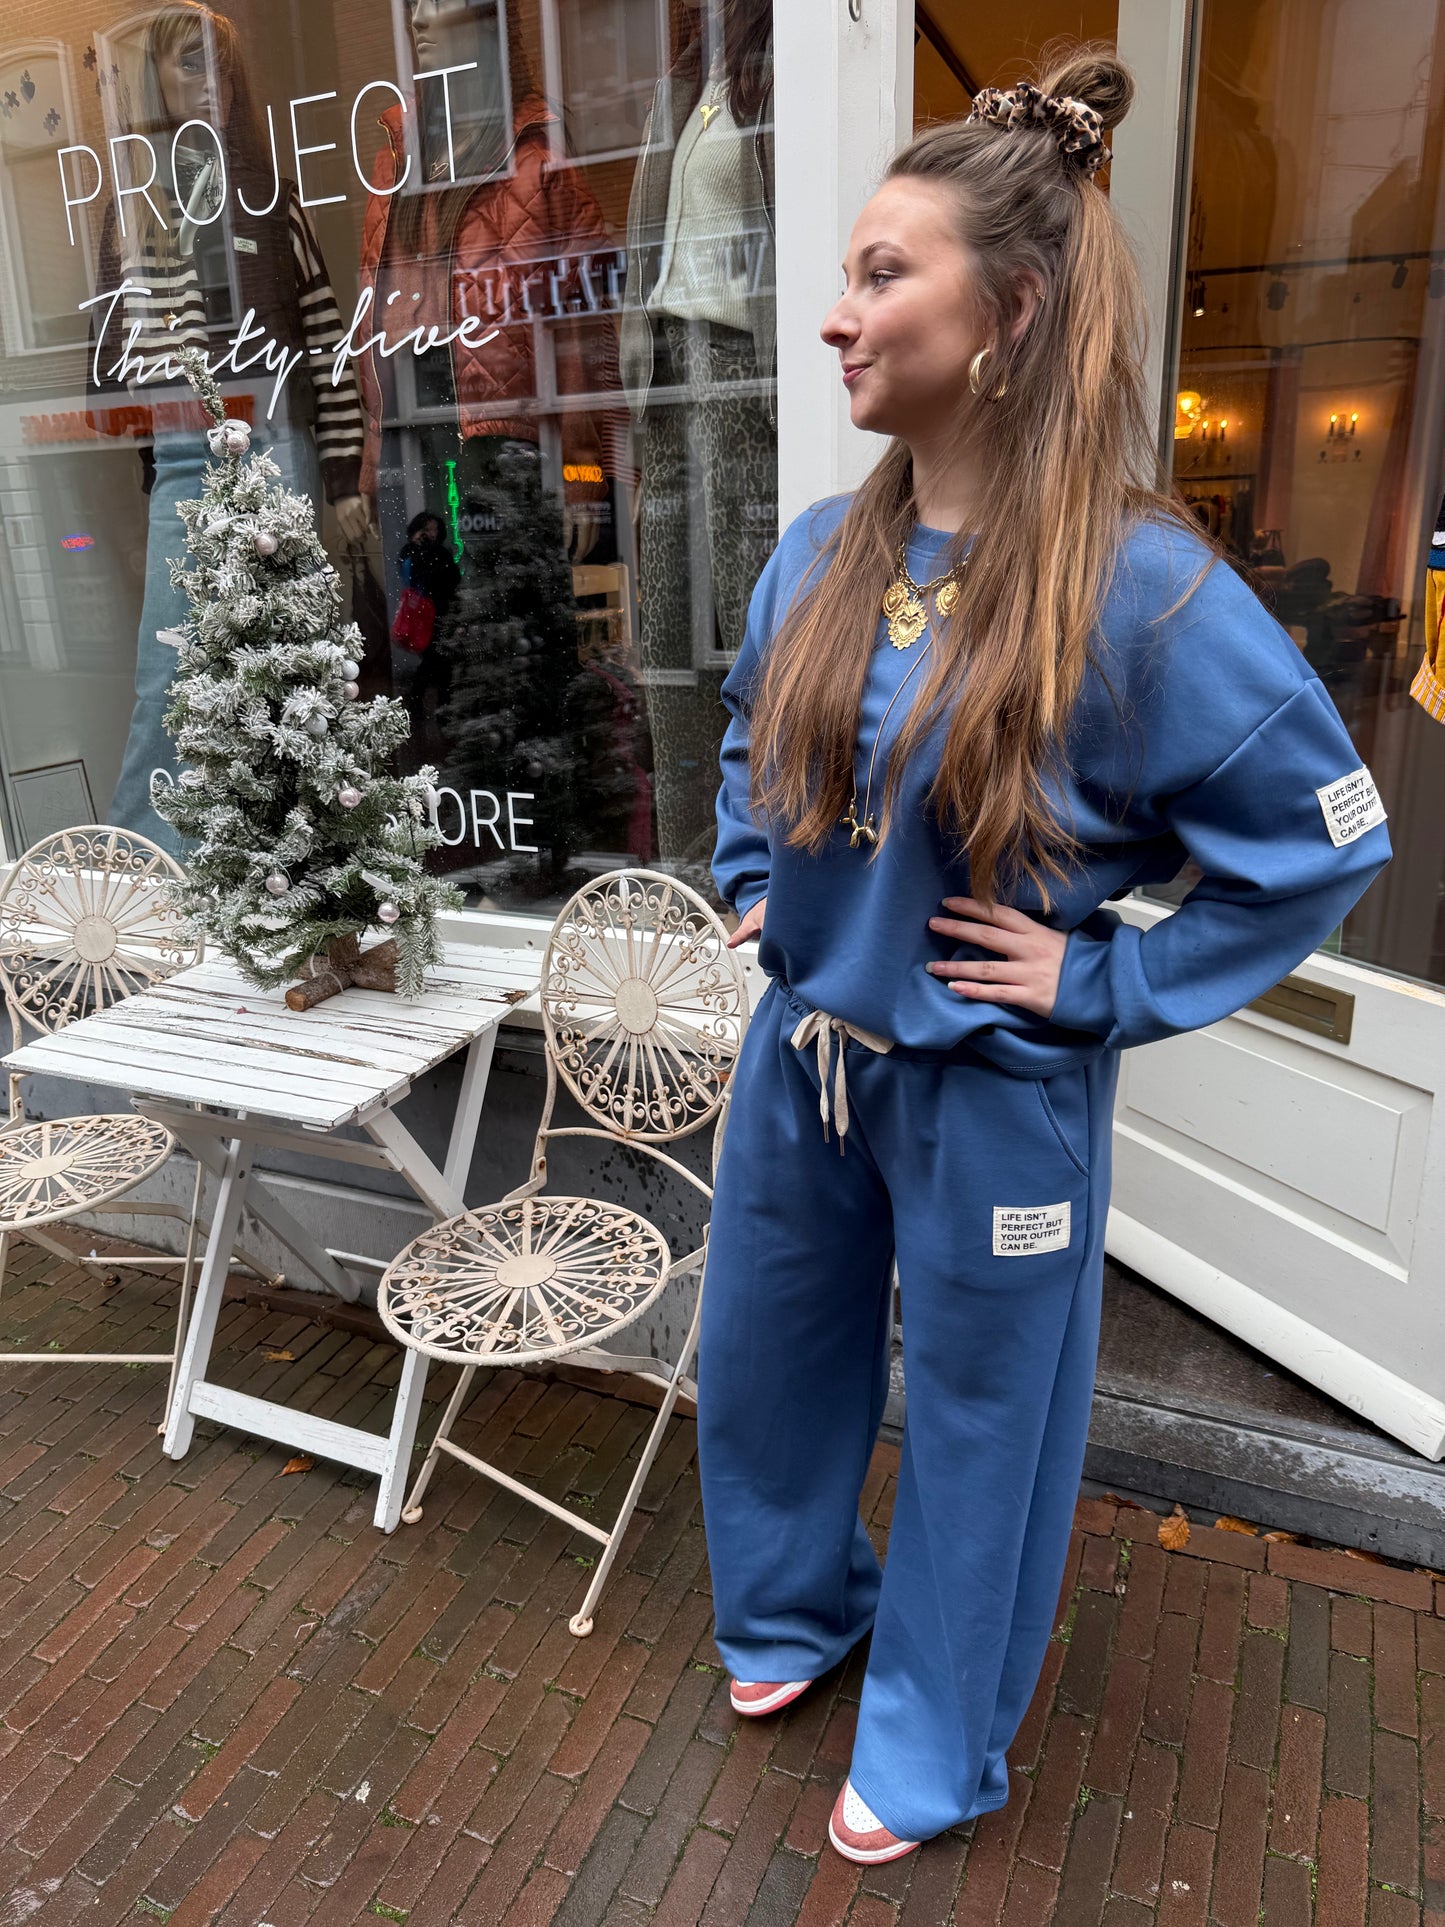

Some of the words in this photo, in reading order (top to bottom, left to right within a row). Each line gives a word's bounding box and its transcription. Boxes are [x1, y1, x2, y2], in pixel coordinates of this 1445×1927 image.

[57, 62, 478, 246] PROJECT
[1328, 788, 1346, 802] LIFE
[1345, 778, 1364, 793] ISN'T
[1332, 791, 1364, 814] PERFECT
[1336, 810, 1356, 825] YOUR
[1340, 824, 1357, 838] CAN
[1024, 1213, 1047, 1221] ISN'T
[1001, 1223, 1044, 1231] PERFECT
[1046, 1219, 1063, 1228] BUT
[1030, 1229, 1061, 1239] OUTFIT
[1023, 1242, 1037, 1250] BE.
